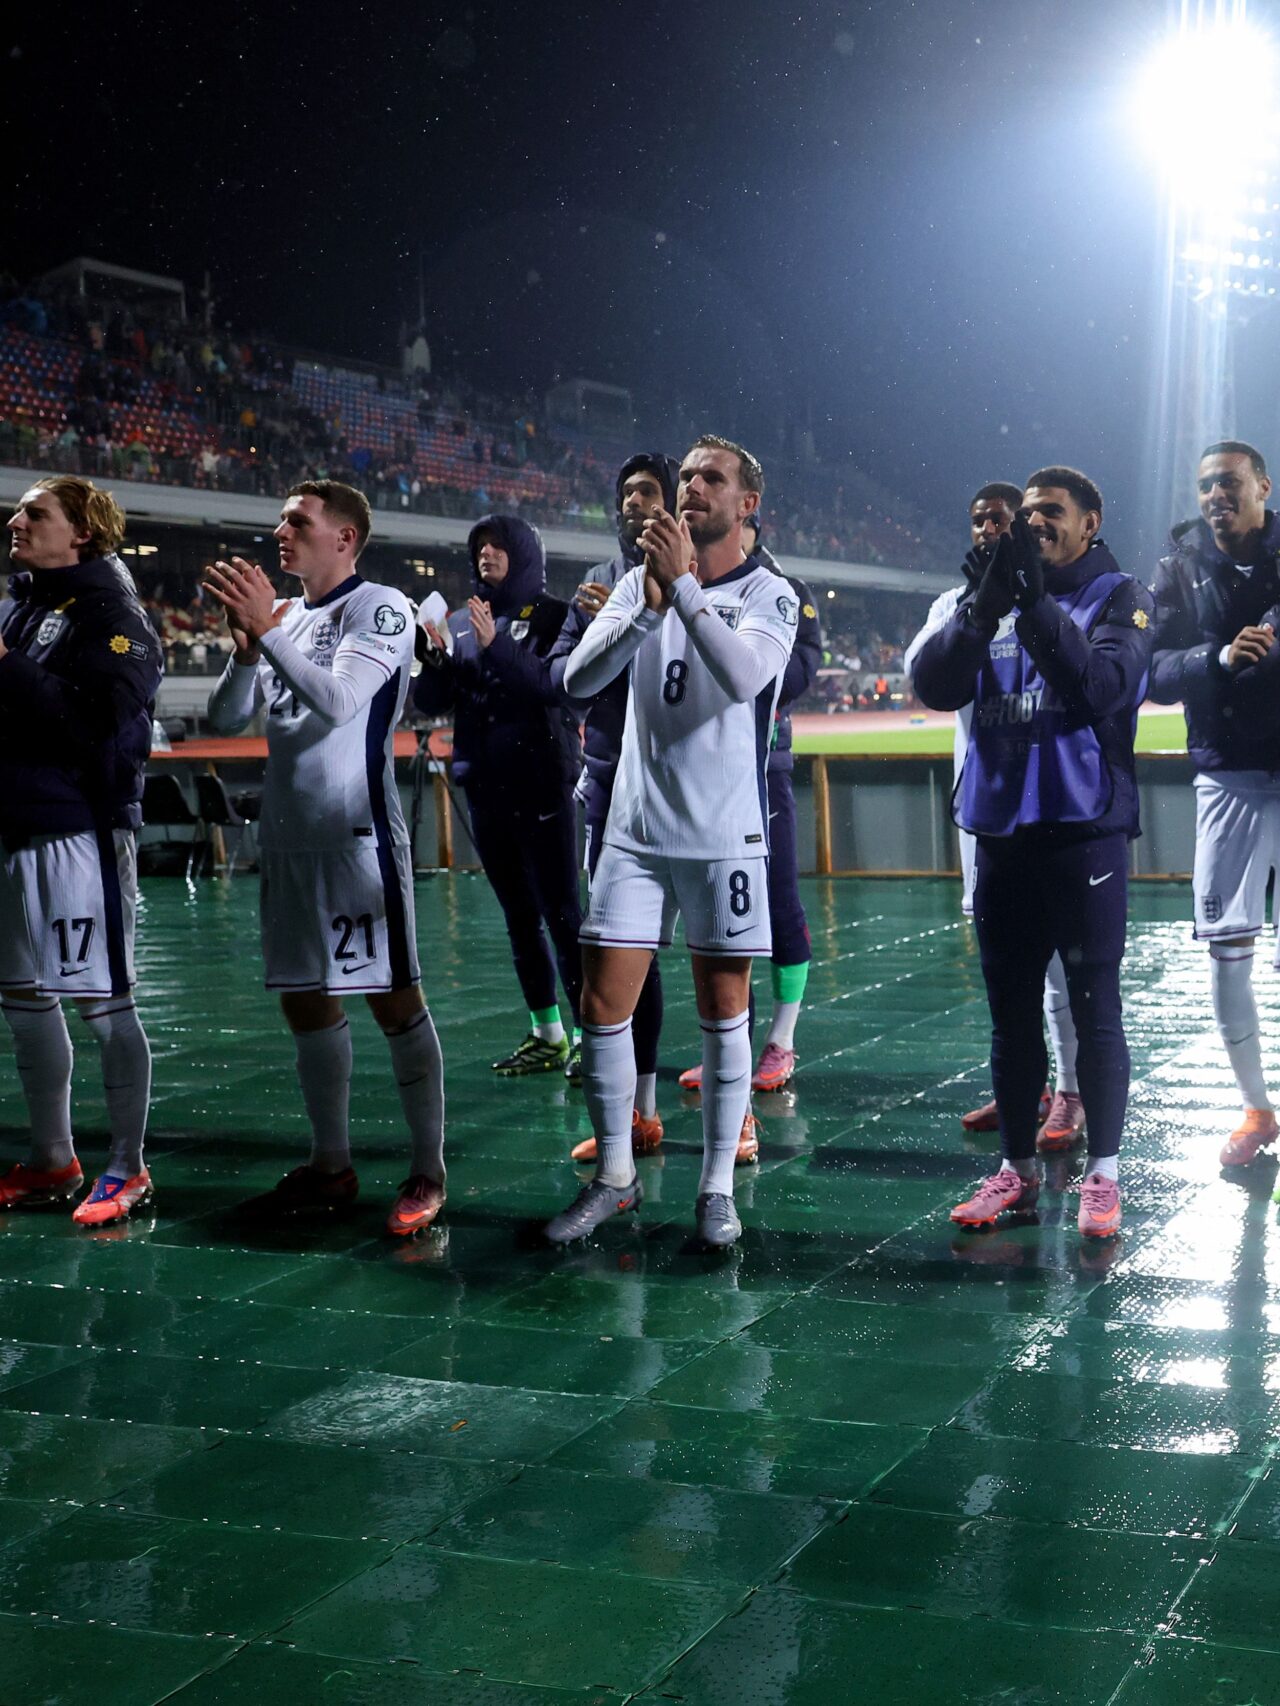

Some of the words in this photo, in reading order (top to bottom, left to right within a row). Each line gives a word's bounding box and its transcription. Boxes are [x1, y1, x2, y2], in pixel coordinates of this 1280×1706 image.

[663, 659, 689, 707] 8
[729, 869, 752, 918] 8
[52, 917, 95, 963] 17
[332, 912, 376, 962] 21
